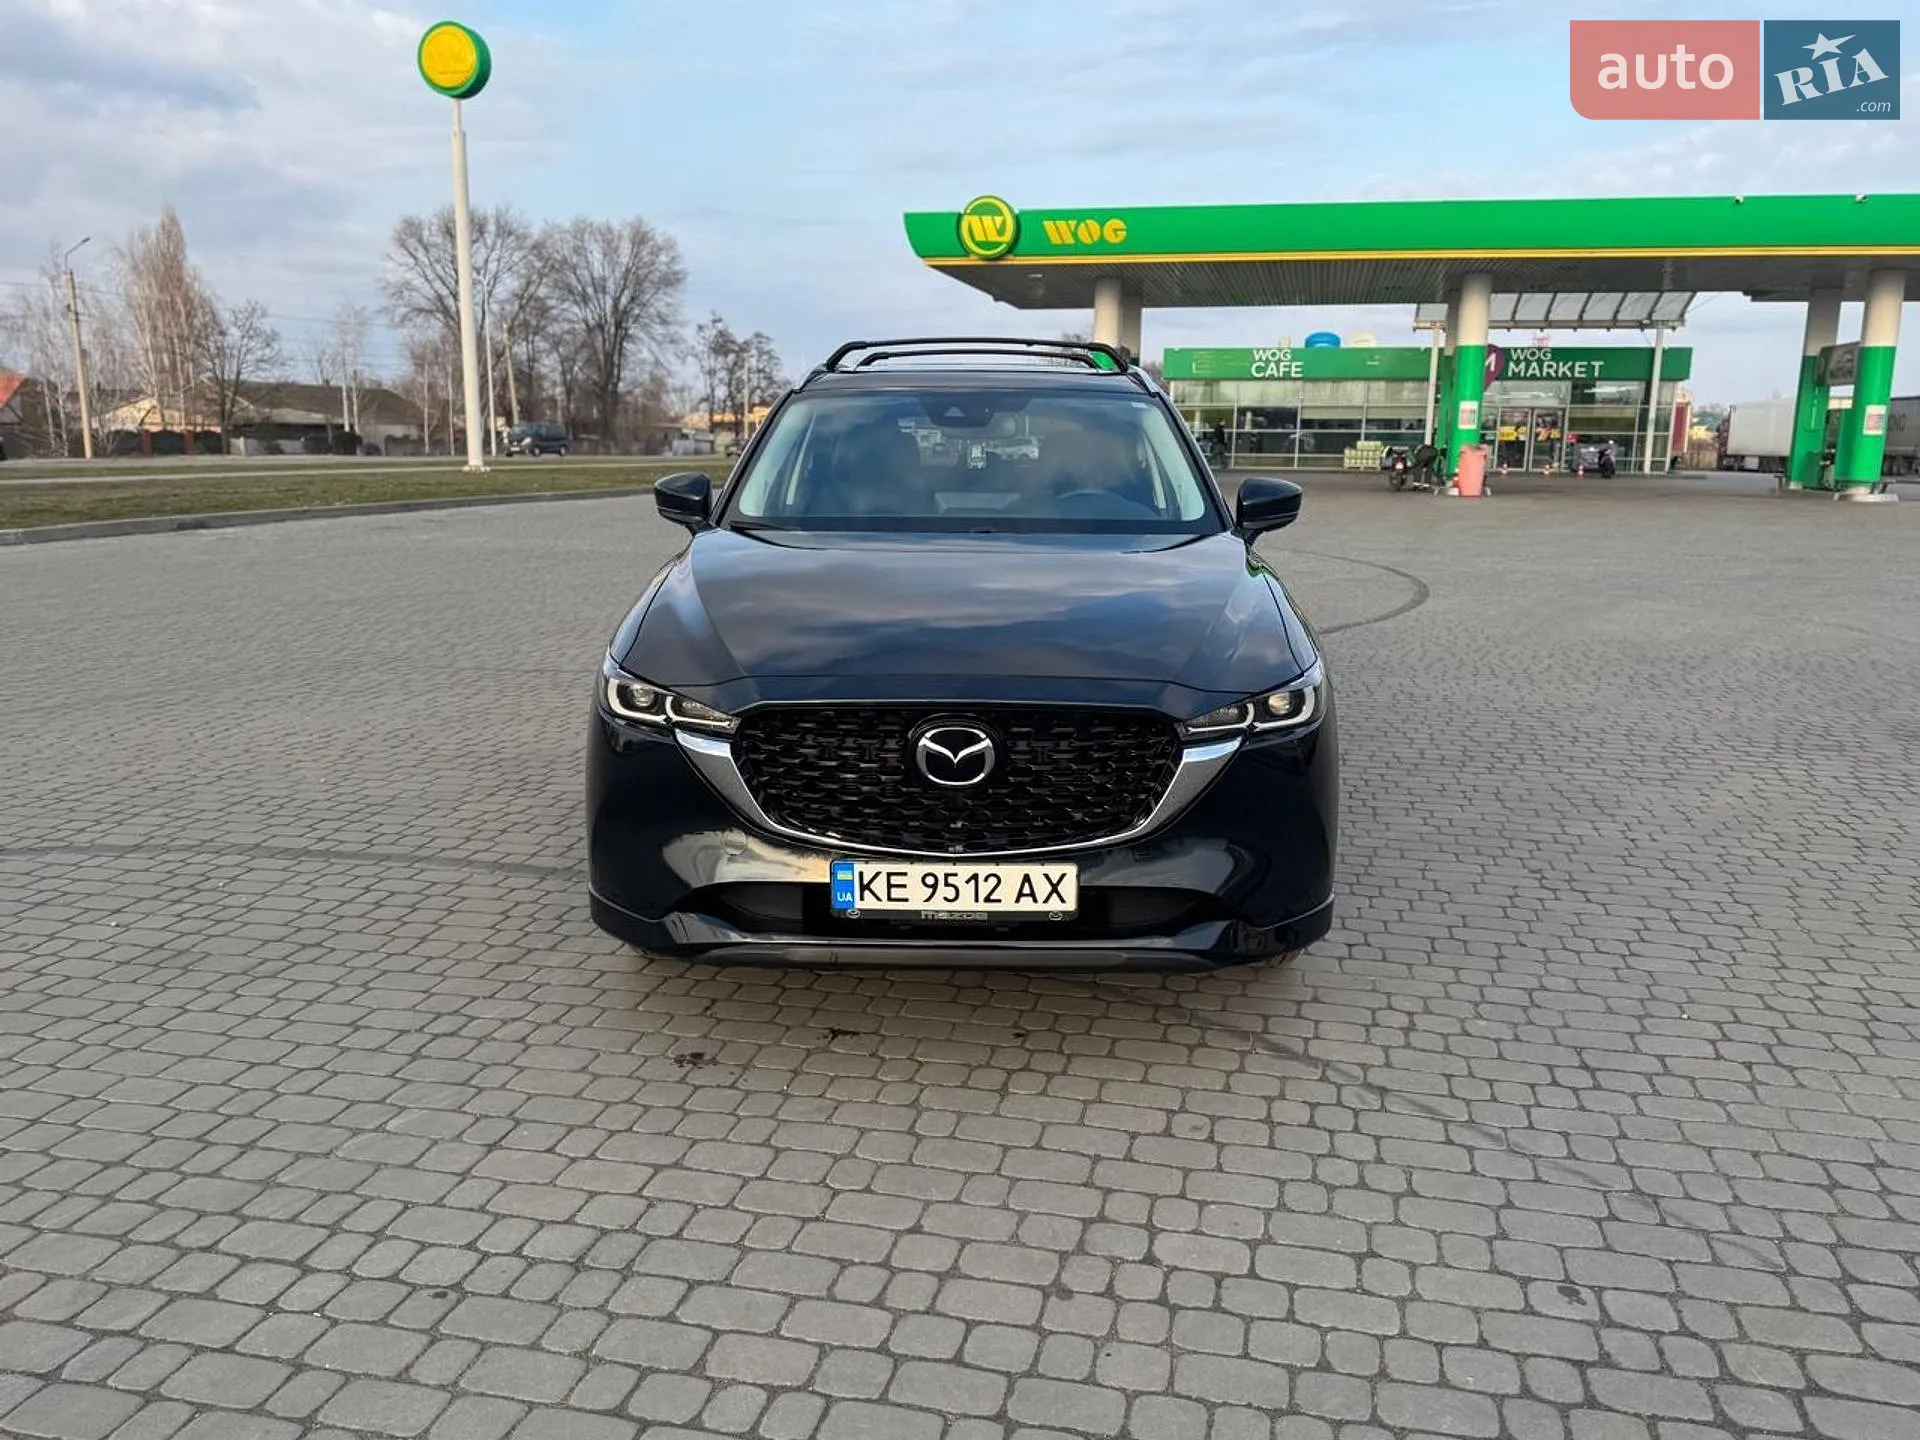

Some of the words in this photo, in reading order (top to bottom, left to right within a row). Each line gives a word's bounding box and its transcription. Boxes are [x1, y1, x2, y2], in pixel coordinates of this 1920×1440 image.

[1043, 218, 1126, 245] WOG
[1253, 349, 1292, 361] WOG
[1510, 348, 1551, 360] WOG
[1251, 361, 1304, 378] CAFE
[1508, 360, 1605, 378] MARKET
[858, 871, 909, 903] KE
[920, 872, 1003, 903] 9512
[1014, 872, 1068, 904] AX
[837, 891, 853, 902] UA
